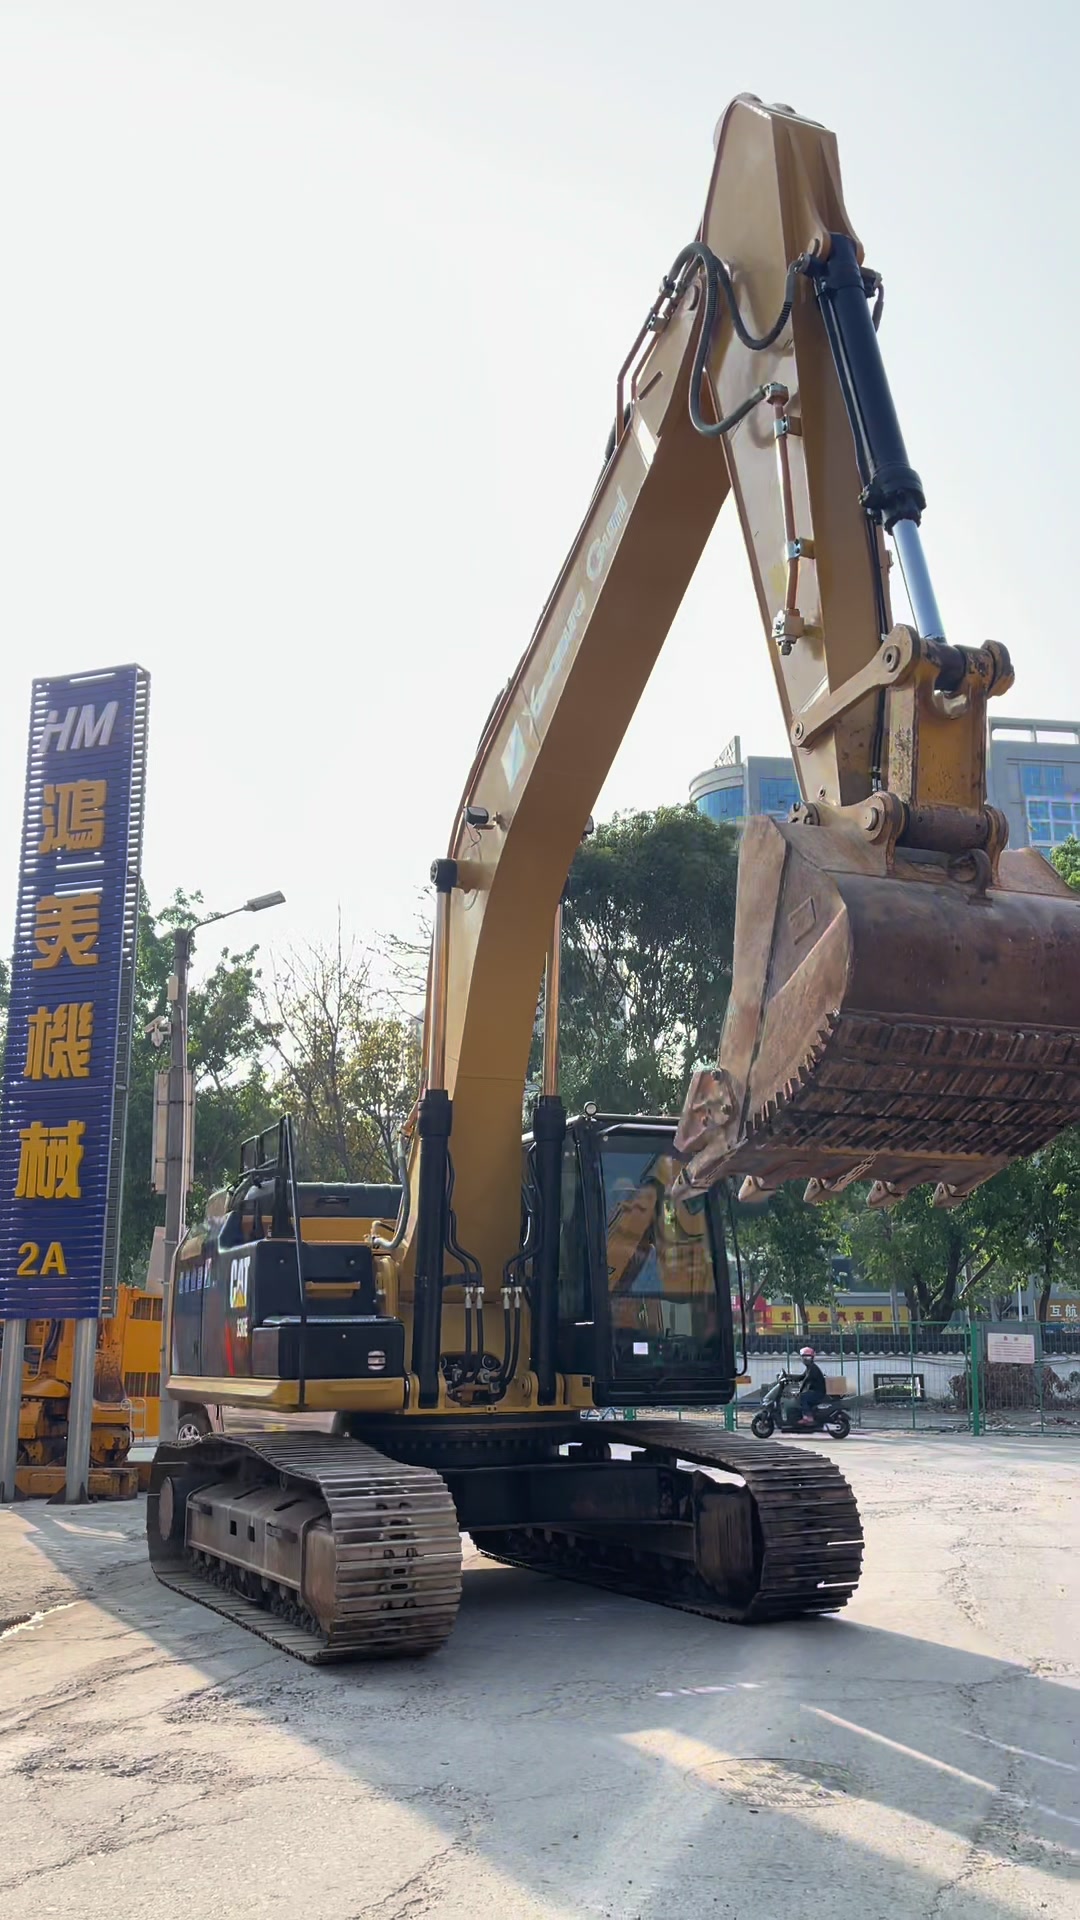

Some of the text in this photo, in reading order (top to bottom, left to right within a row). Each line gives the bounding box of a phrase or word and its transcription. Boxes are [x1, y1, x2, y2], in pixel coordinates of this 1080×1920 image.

[36, 701, 119, 752] HM
[16, 1241, 68, 1276] 2A
[230, 1256, 251, 1309] CAT
